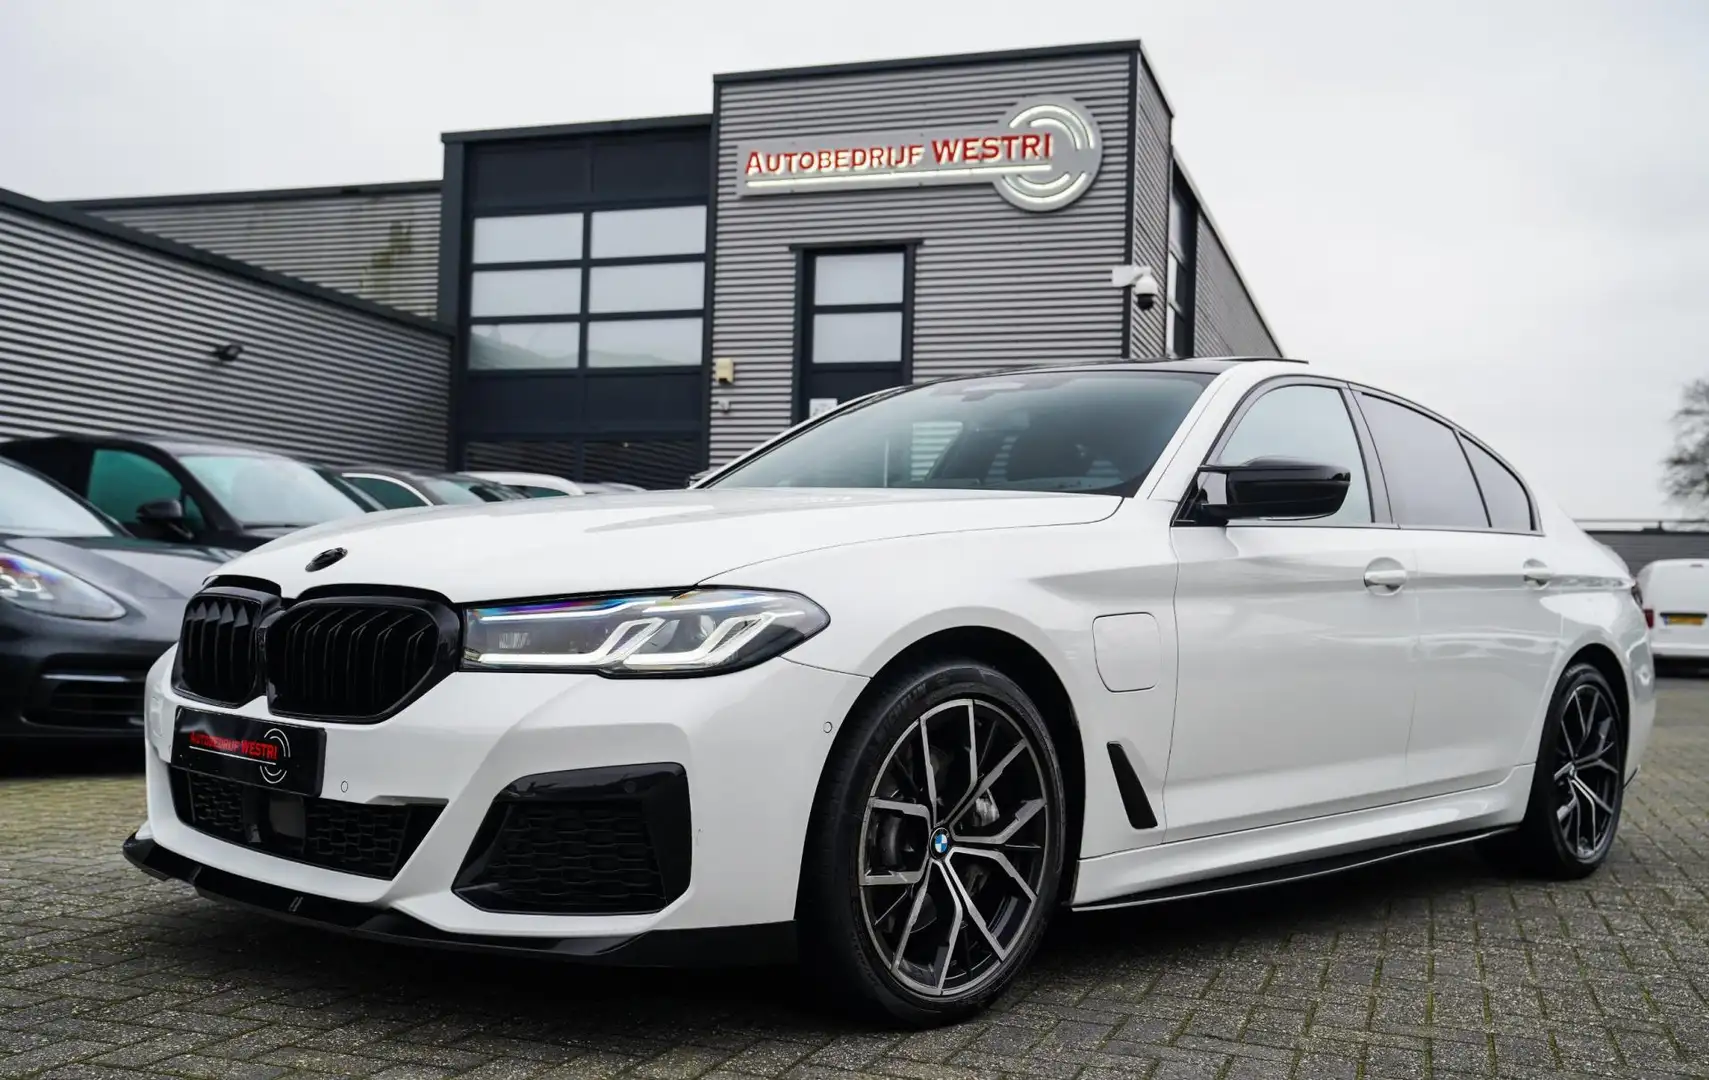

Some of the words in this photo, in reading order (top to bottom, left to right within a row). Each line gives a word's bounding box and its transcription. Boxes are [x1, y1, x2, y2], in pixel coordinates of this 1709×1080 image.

[745, 144, 925, 175] AUTOBEDRIJF
[932, 133, 1053, 165] WESTRI
[241, 739, 278, 760] WESTRI
